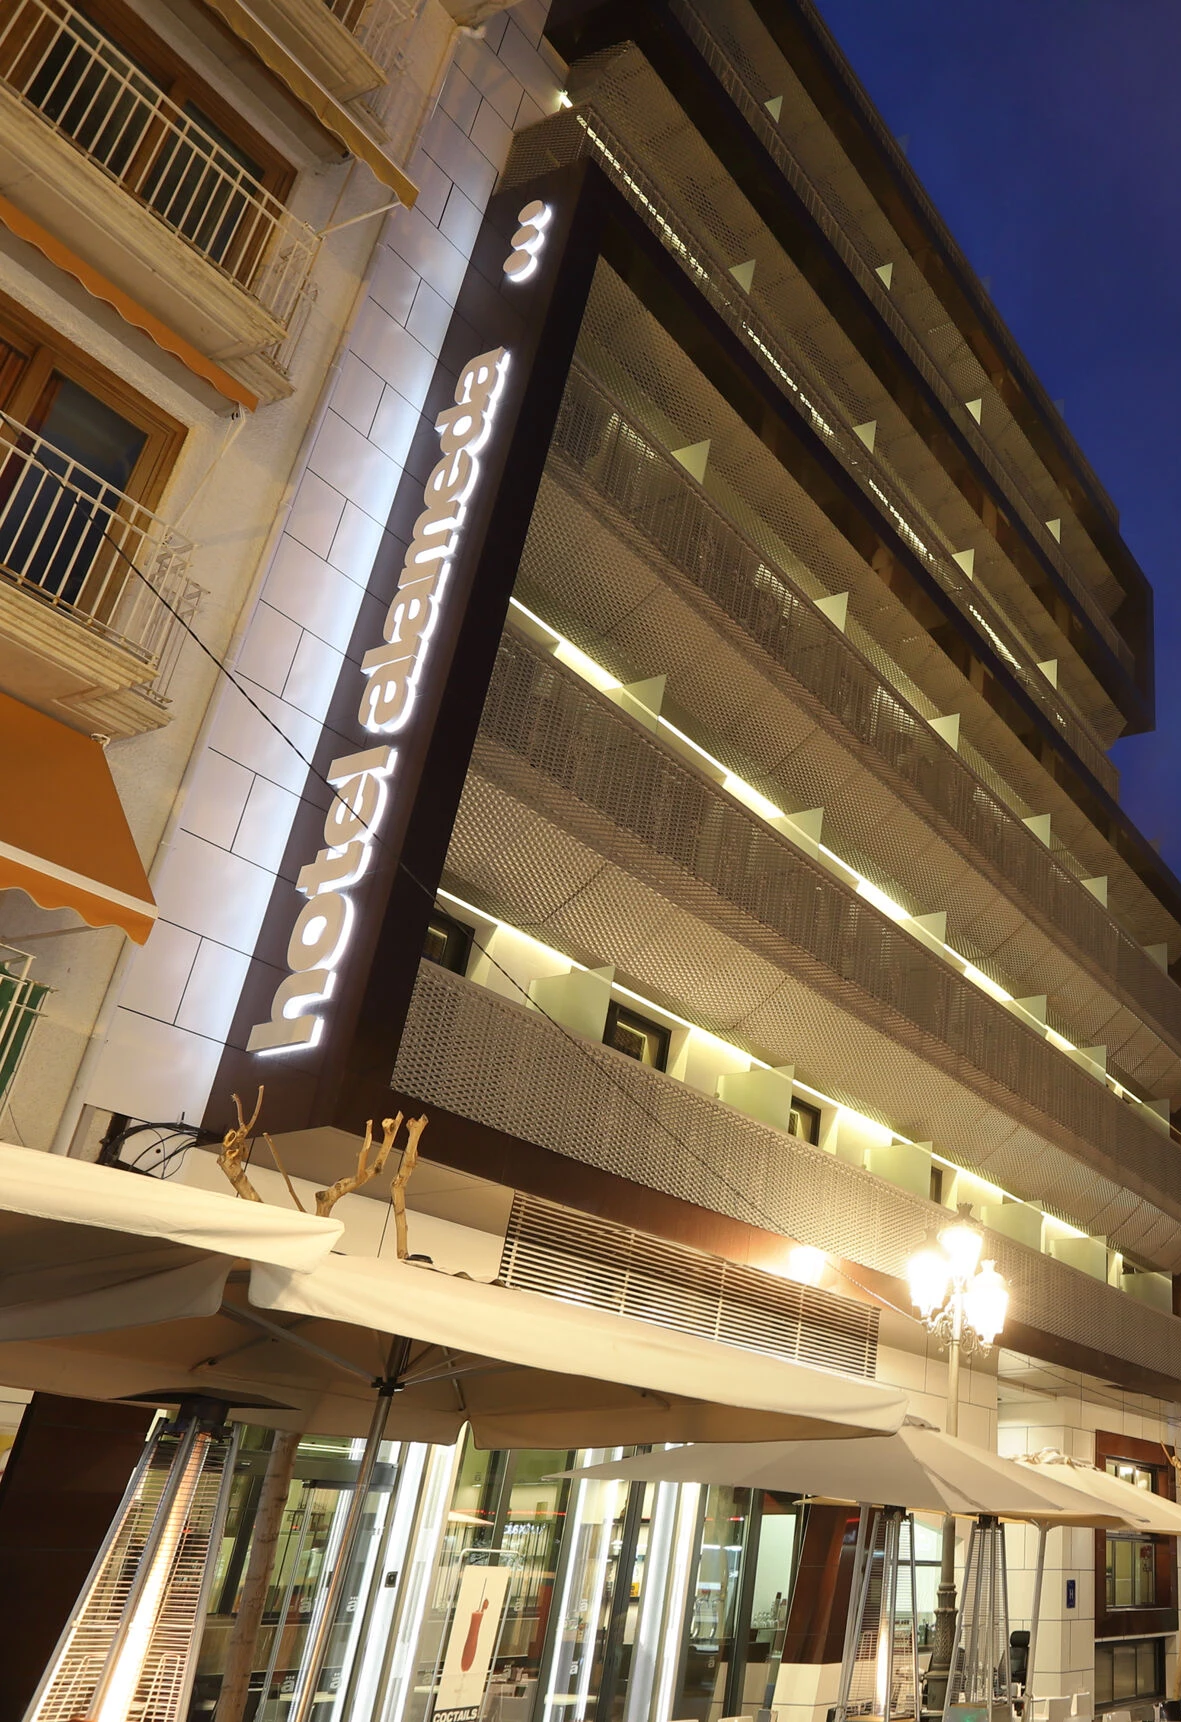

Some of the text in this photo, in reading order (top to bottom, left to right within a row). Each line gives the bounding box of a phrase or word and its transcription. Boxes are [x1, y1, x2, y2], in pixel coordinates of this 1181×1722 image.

[246, 346, 511, 1056] hotel alameda
[433, 1708, 478, 1722] COCTAILS
